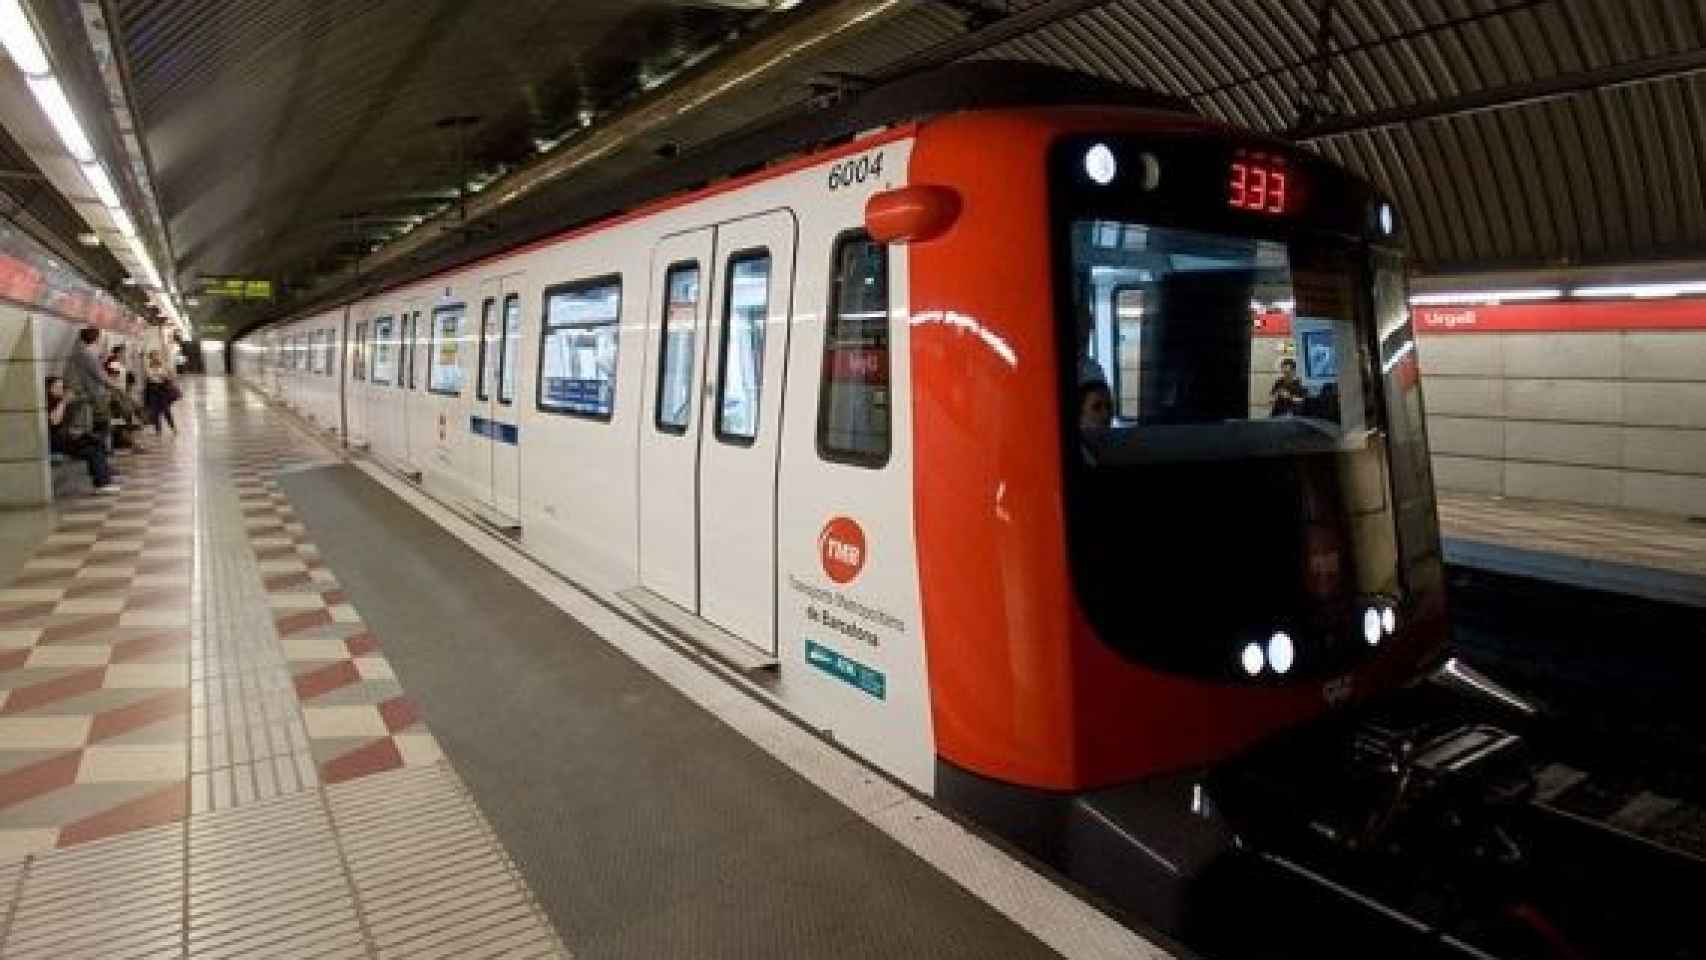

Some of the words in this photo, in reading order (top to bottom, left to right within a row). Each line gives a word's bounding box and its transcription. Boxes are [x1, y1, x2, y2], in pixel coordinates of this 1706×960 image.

[828, 151, 884, 191] 6004
[1228, 164, 1285, 213] 333
[1423, 310, 1477, 328] Urgell
[828, 540, 860, 567] TMB
